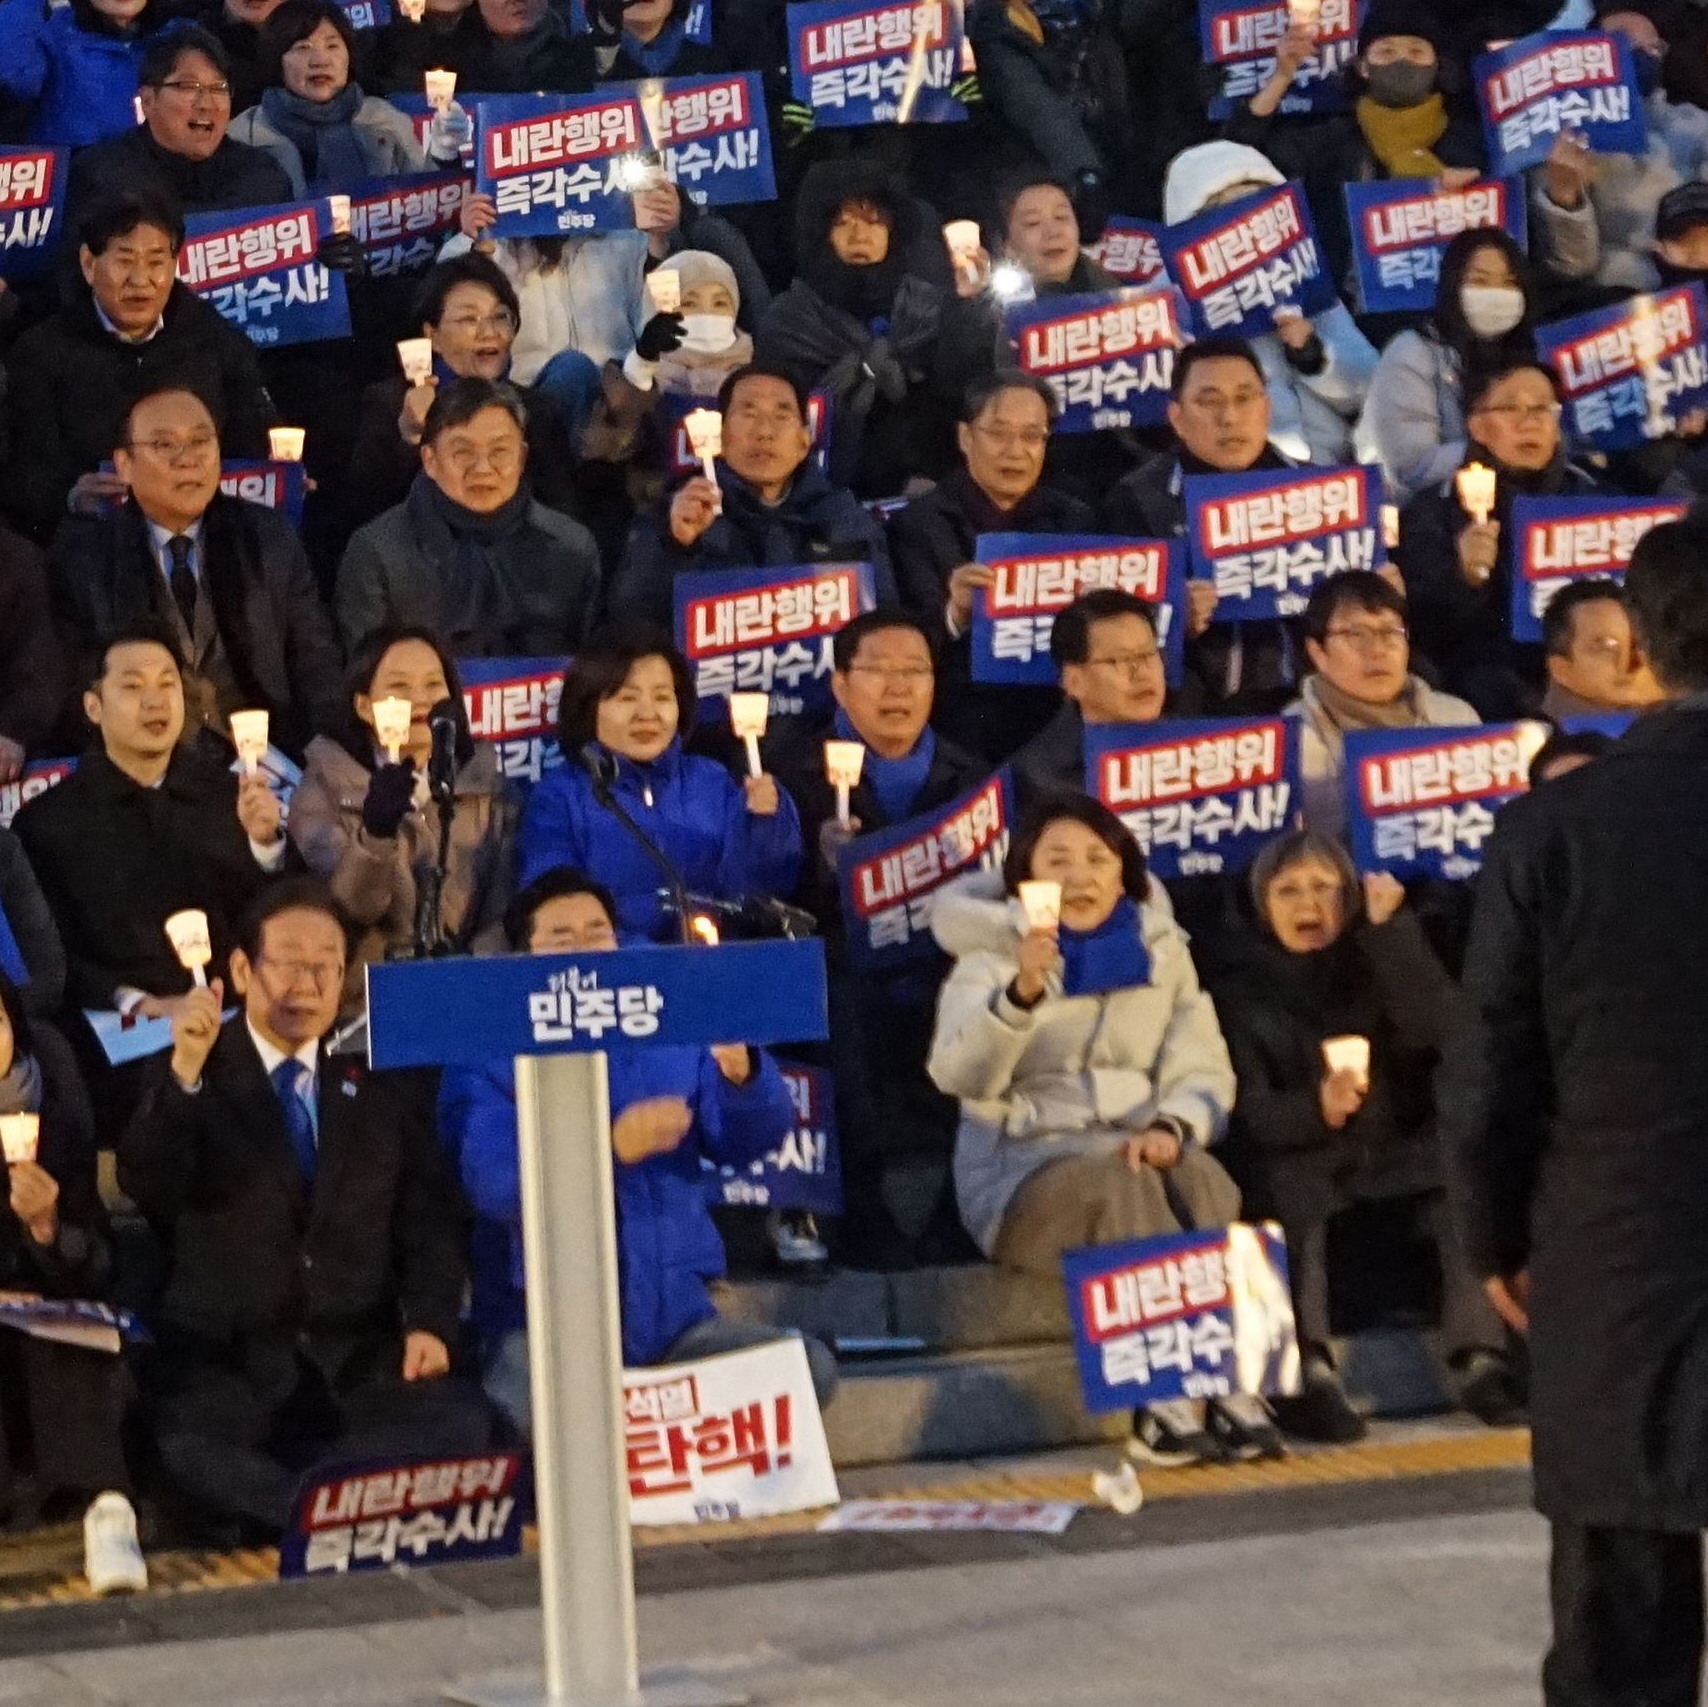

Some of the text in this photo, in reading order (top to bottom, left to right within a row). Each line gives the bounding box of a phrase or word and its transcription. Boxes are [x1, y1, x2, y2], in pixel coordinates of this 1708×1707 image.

[1496, 43, 1615, 113] 내란행위
[494, 104, 637, 168] 내란행위
[181, 218, 312, 284] 내란행위
[1185, 199, 1301, 290] 내란행위
[1371, 190, 1499, 247] 내란행위
[1023, 301, 1171, 370] 내란행위
[1210, 475, 1361, 547] 내란행위
[1213, 531, 1375, 598] 즉각수사!
[697, 577, 849, 654] 내란행위
[1108, 728, 1278, 802] 내란행위
[1364, 732, 1530, 806] 내란행위
[528, 986, 665, 1041] 민주당
[628, 1396, 793, 1496] 탄핵!
[311, 1456, 510, 1522] 내란행위
[305, 1499, 515, 1572] 즉각수사!
